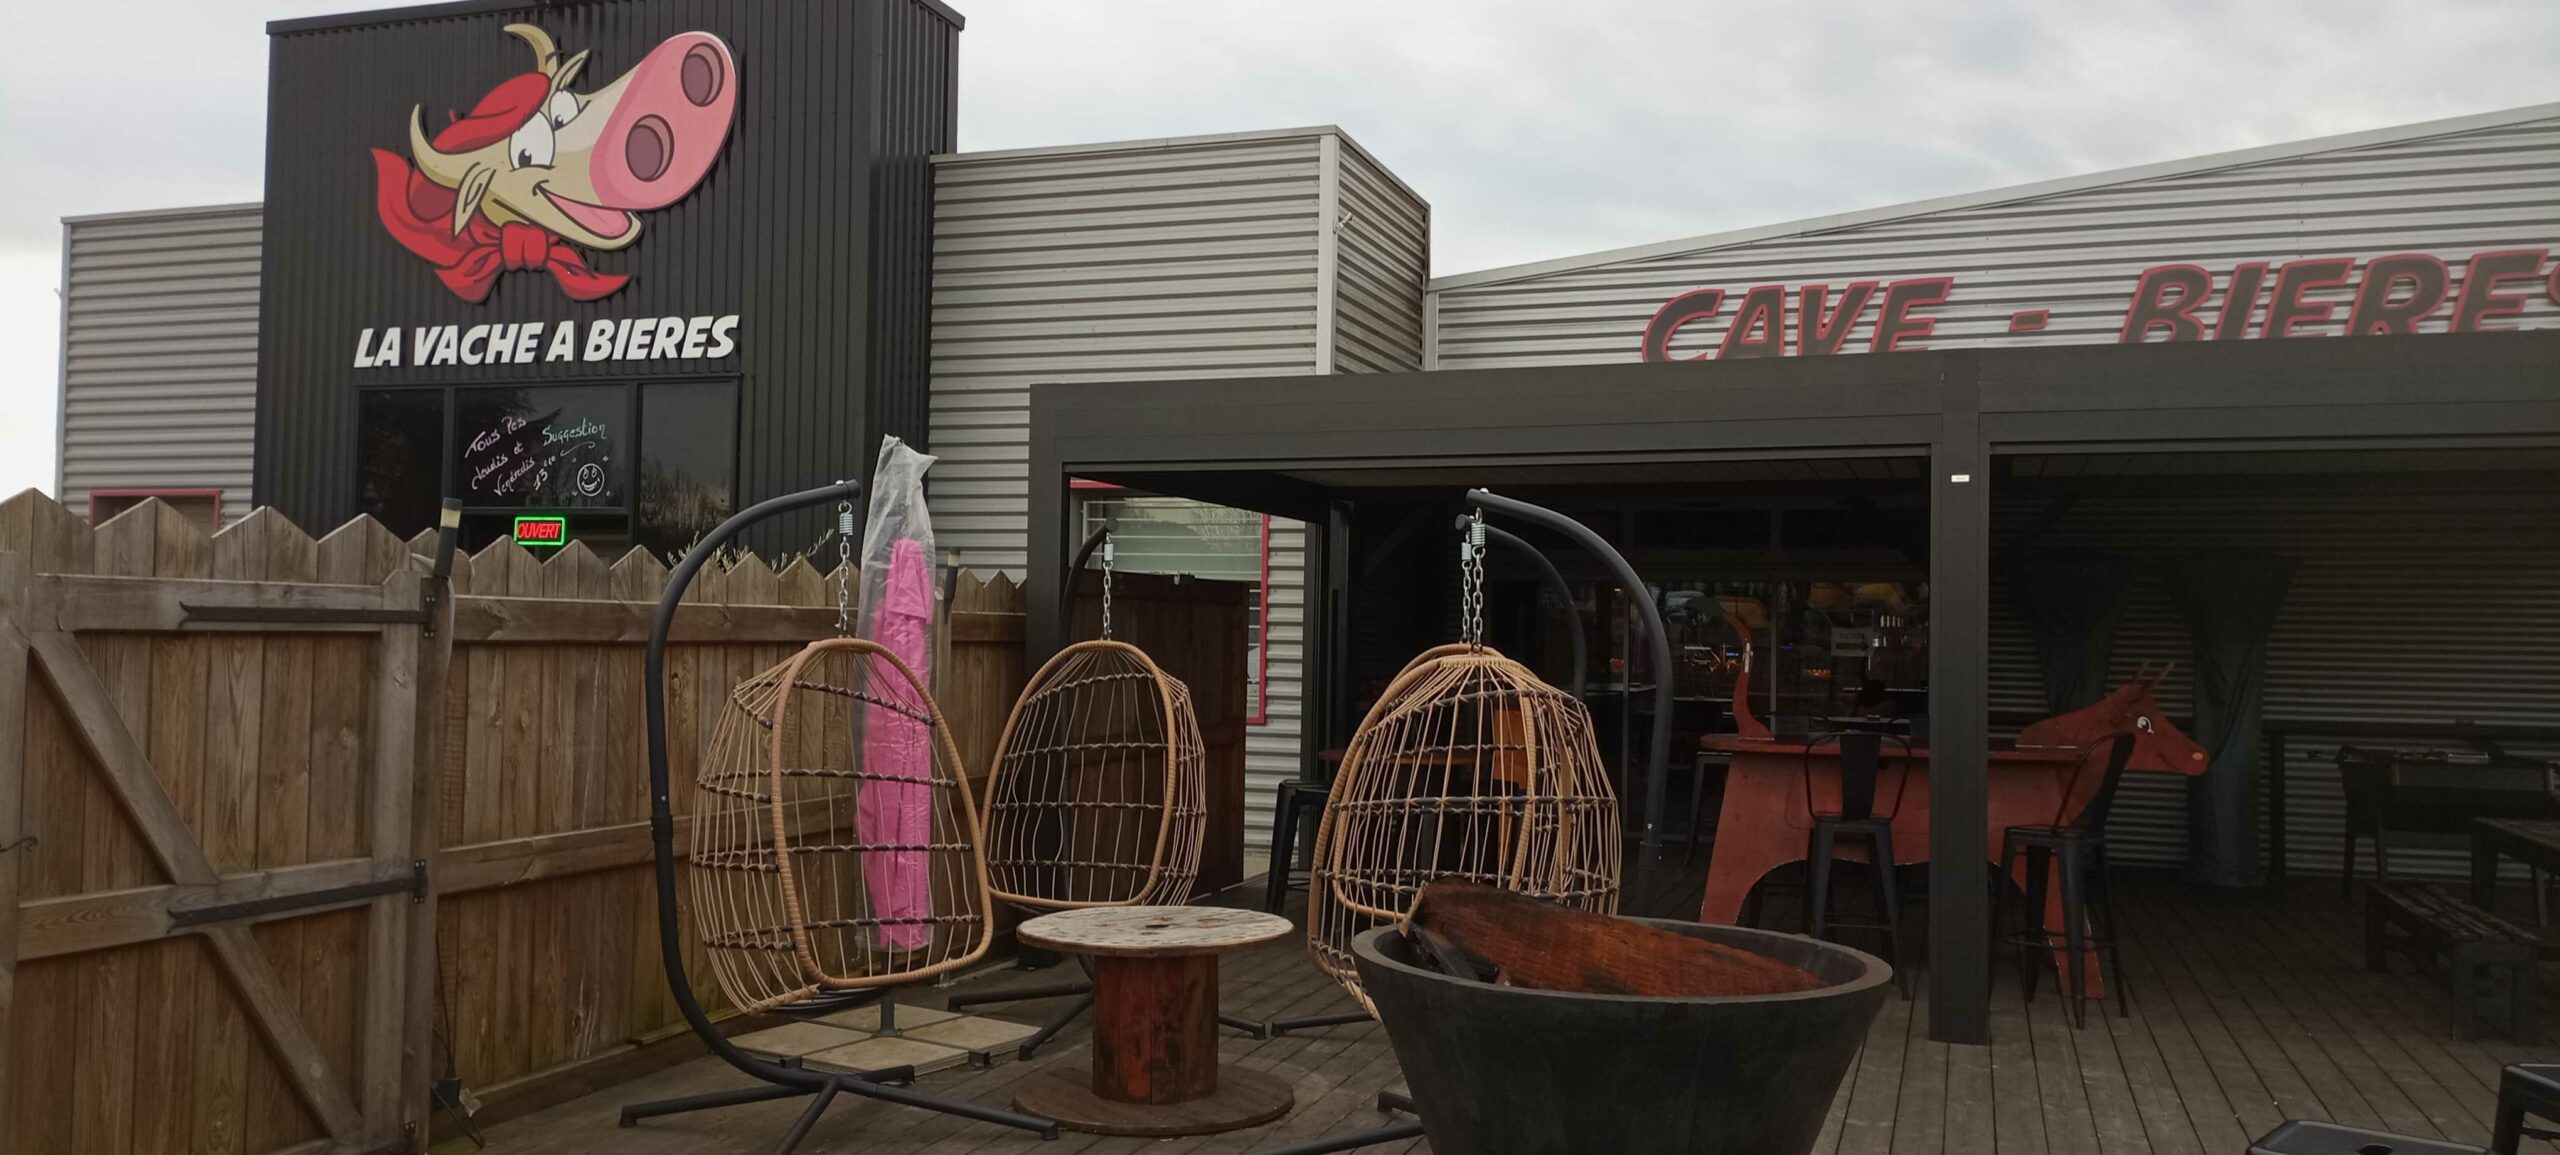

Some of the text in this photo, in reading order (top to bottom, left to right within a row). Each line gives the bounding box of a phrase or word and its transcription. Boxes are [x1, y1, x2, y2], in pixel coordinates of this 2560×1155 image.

[1641, 276, 1955, 363] CAVE
[2118, 248, 2560, 344] BIERE
[353, 315, 740, 368] LA VACHE A BIERES
[541, 417, 608, 447] Suggestion
[517, 522, 562, 539] OUVERT
